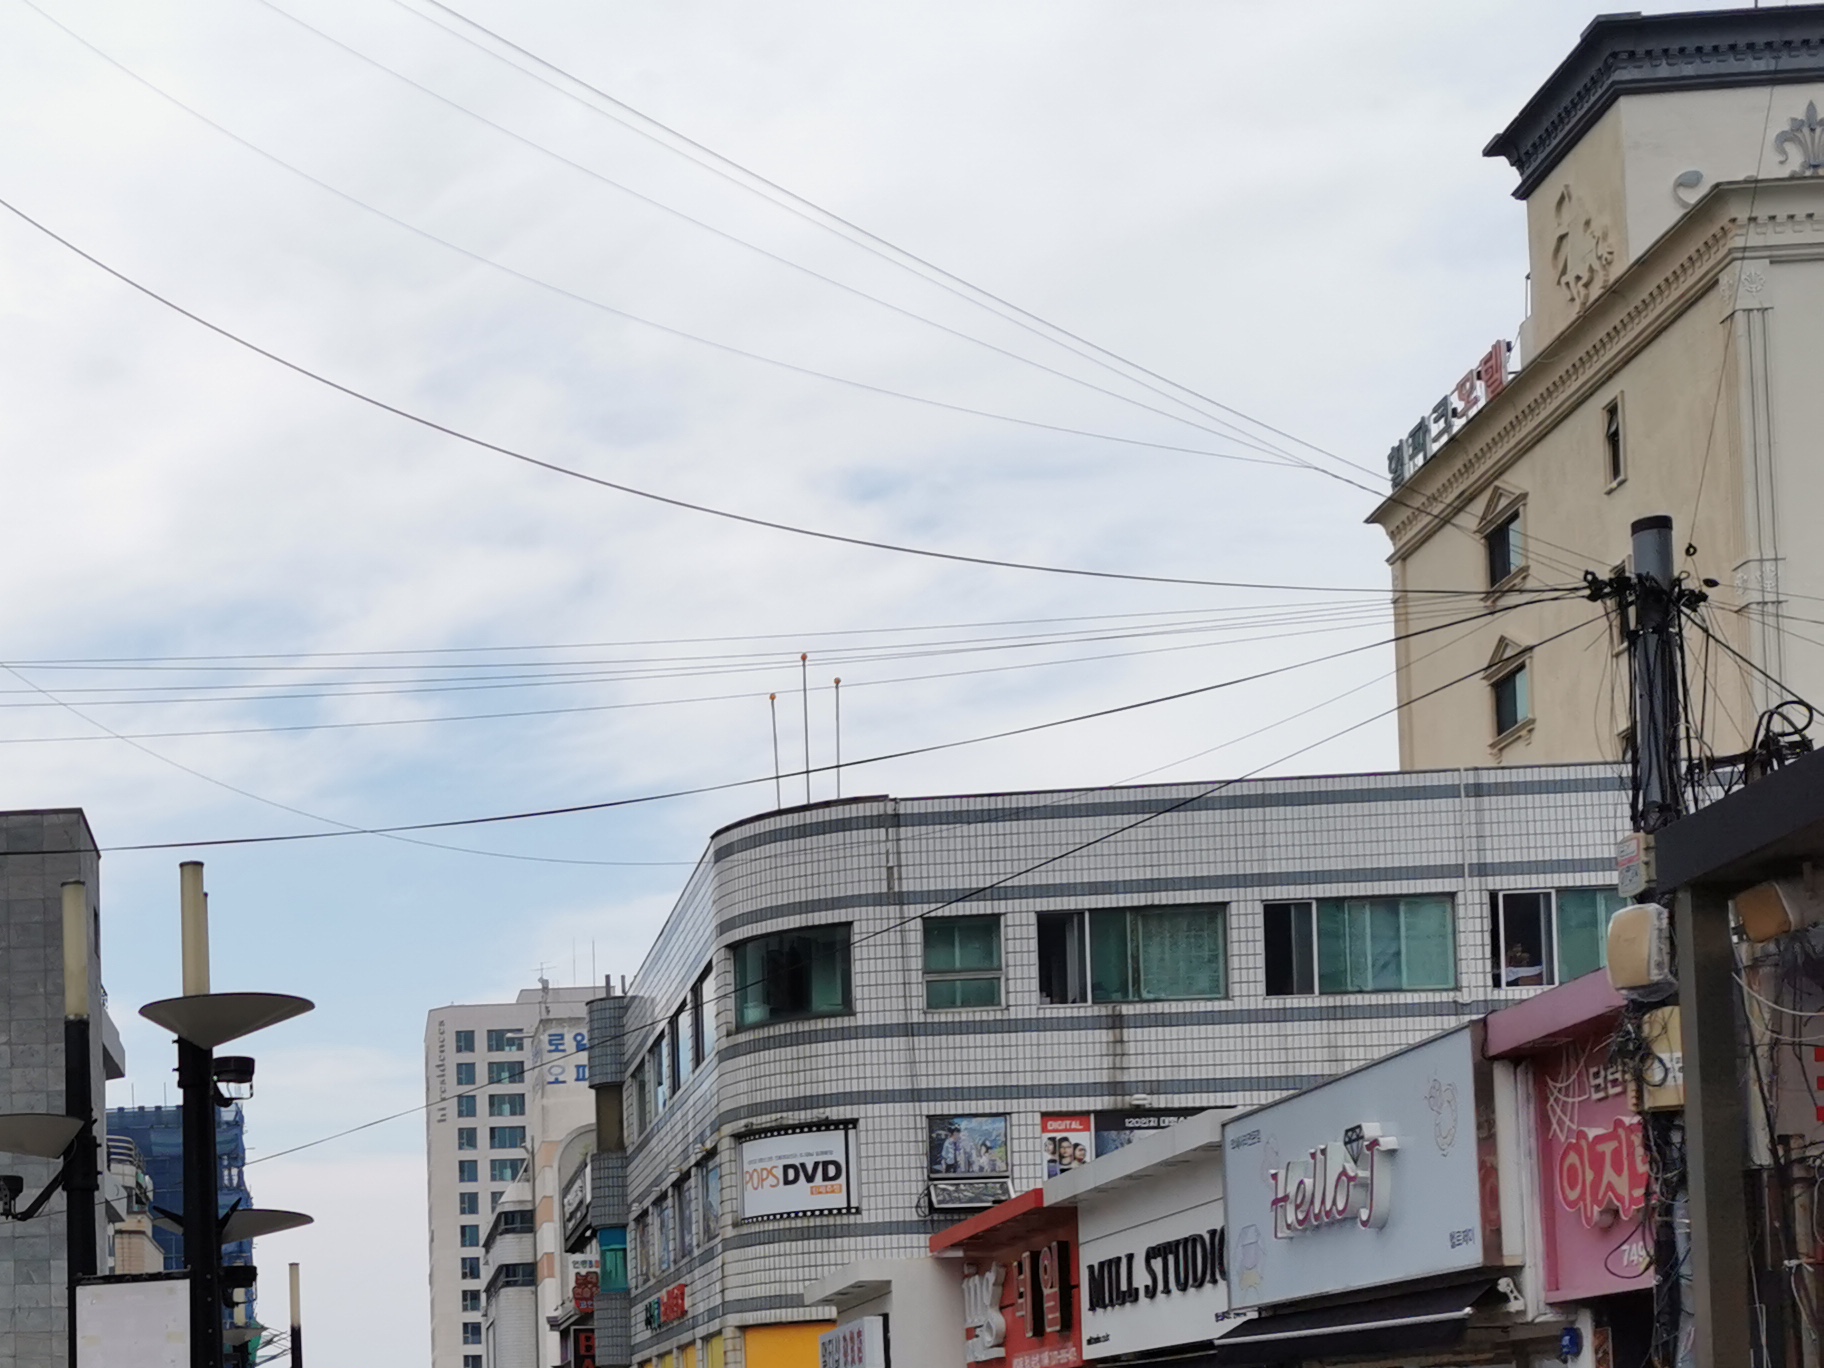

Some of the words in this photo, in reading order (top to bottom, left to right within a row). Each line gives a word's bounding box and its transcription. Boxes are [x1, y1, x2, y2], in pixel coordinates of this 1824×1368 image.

[1047, 1121, 1084, 1131] DIGITAL
[745, 1165, 780, 1191] POPS
[782, 1160, 843, 1186] DVD
[1270, 1142, 1359, 1240] Hello
[1087, 1253, 1139, 1312] MILL
